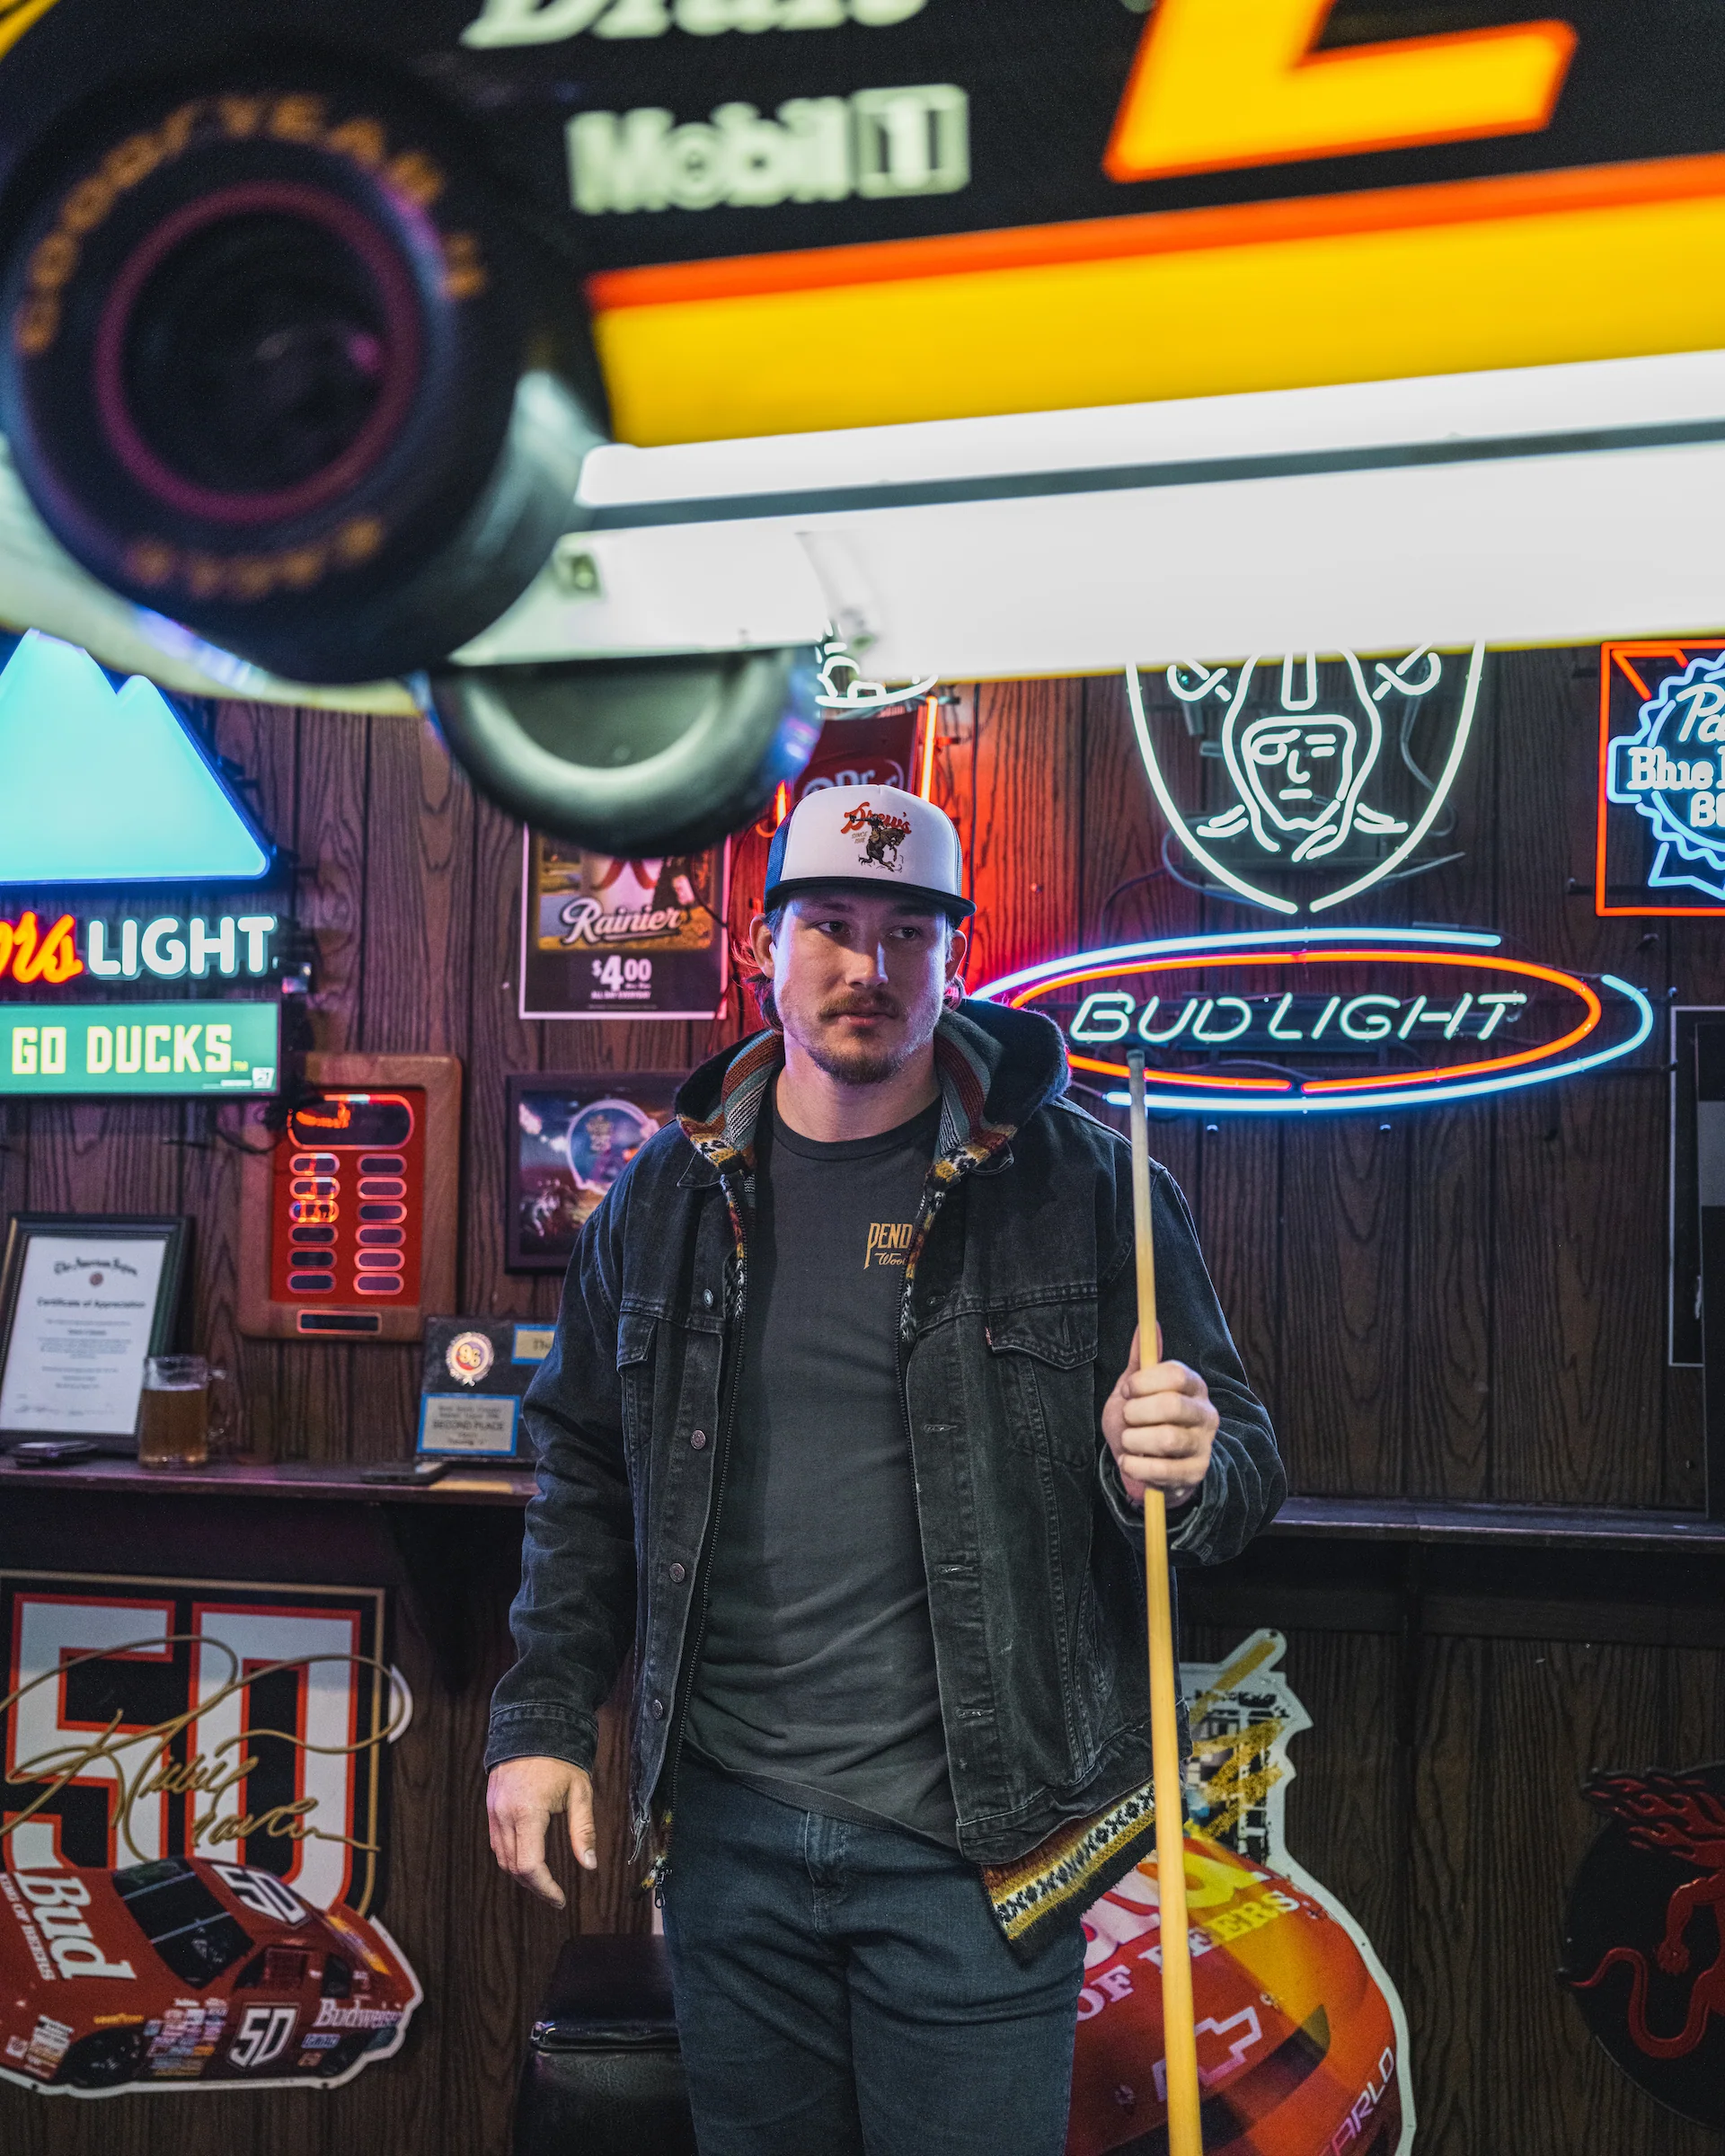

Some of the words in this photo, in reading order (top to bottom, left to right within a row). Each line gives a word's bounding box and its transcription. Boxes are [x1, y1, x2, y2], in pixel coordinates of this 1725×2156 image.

[567, 95, 852, 215] Mobil
[1627, 746, 1714, 791] Blue
[88, 916, 275, 976] LIGHT
[561, 898, 684, 944] Rainier
[1069, 991, 1253, 1043] BUD
[1267, 992, 1528, 1041] LIGHT
[12, 1026, 67, 1074] GO
[86, 1024, 232, 1074] DUCKS
[863, 1223, 913, 1269] PEND
[211, 1864, 307, 1925] 50
[13, 1871, 137, 1980] Bud
[228, 2007, 297, 2068] 50
